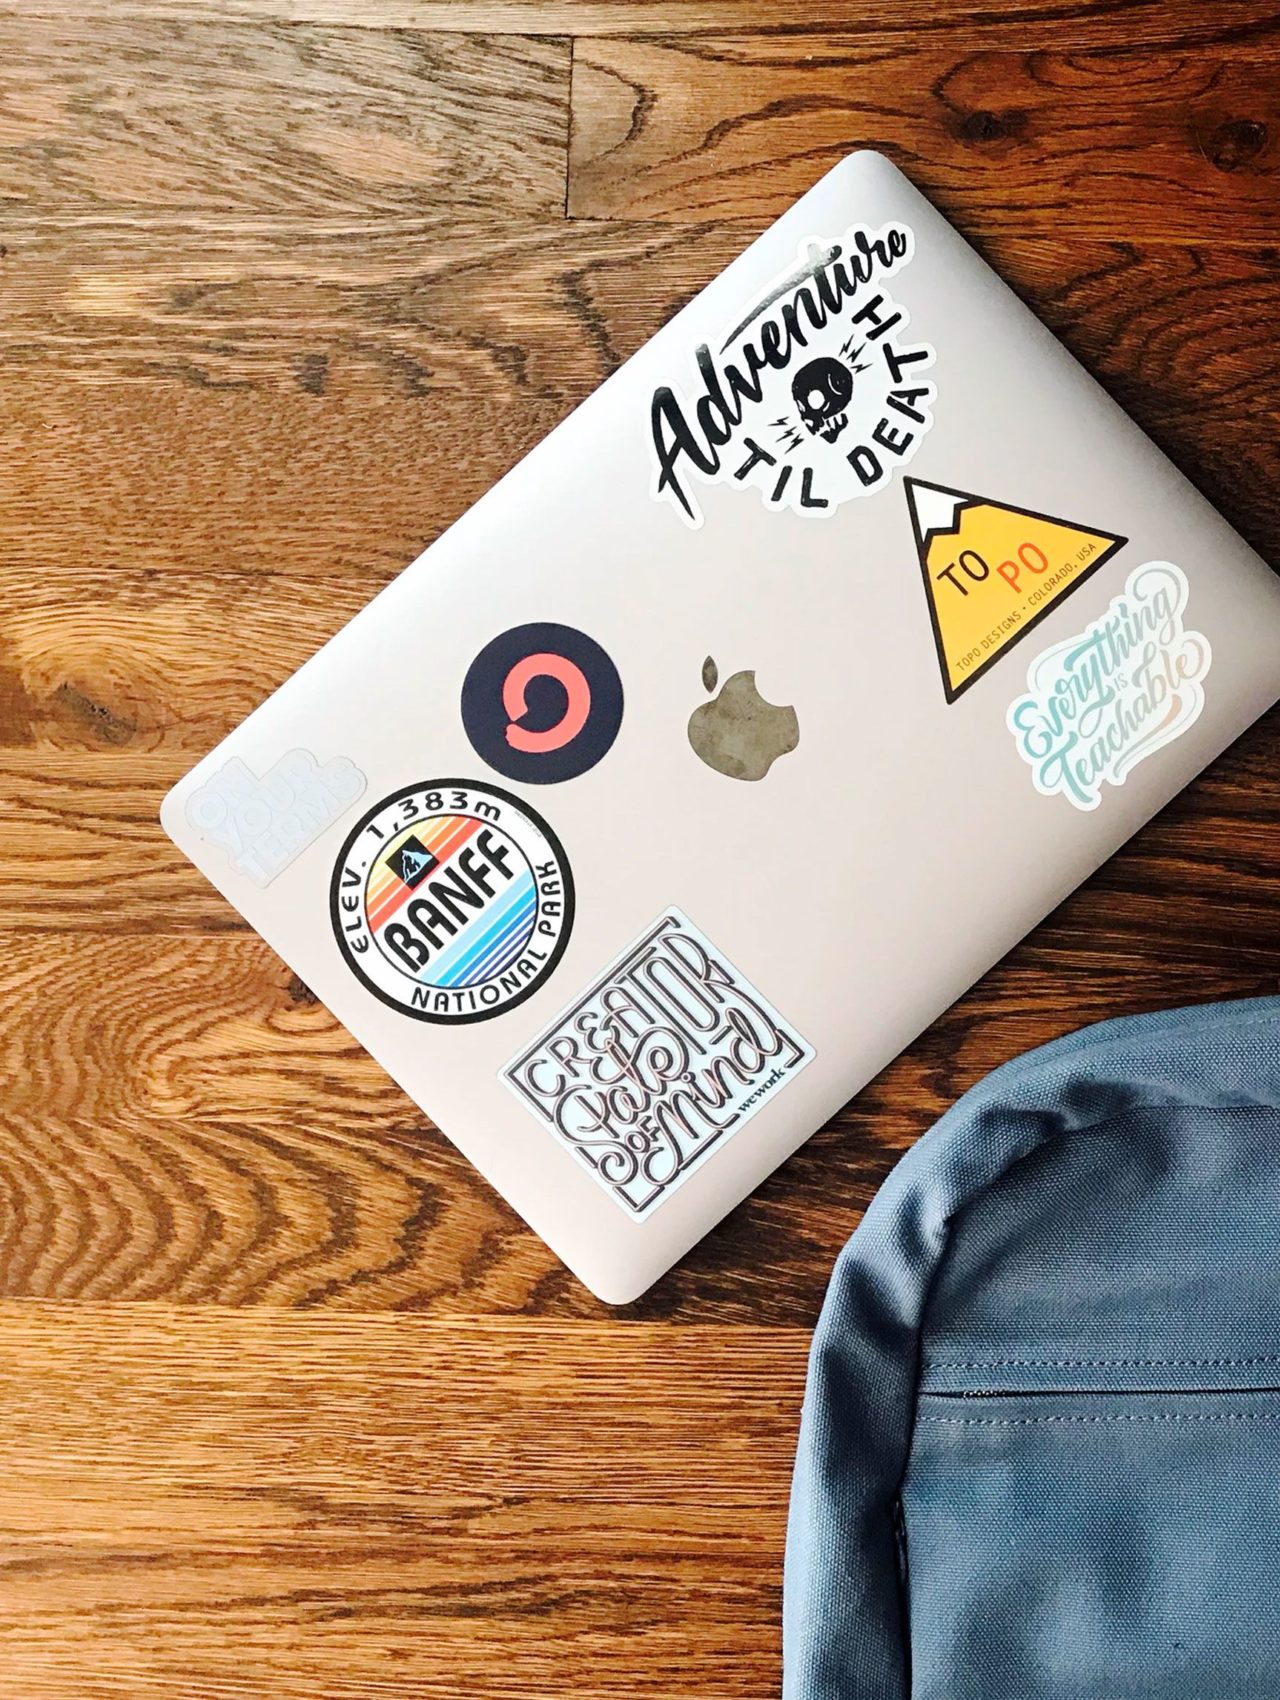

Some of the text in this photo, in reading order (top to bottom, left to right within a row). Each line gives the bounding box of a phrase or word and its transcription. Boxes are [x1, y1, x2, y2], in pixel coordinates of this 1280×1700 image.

[651, 229, 907, 521] Adventure
[733, 294, 930, 509] TIL DEATH
[936, 542, 1049, 597] TO PO
[955, 647, 982, 671] TOPO
[980, 610, 1022, 649] DESIGNS
[1077, 543, 1097, 562] USA
[1014, 568, 1181, 759] Everything
[1040, 638, 1205, 803] Teachable
[1114, 673, 1129, 692] IS
[366, 791, 502, 839] 1,383m
[383, 829, 514, 974] BANFF
[411, 860, 562, 1013] NATIONAL PARK
[524, 933, 726, 1097] CREATOR
[737, 1068, 786, 1113] wework
[641, 1007, 784, 1185] Mind
